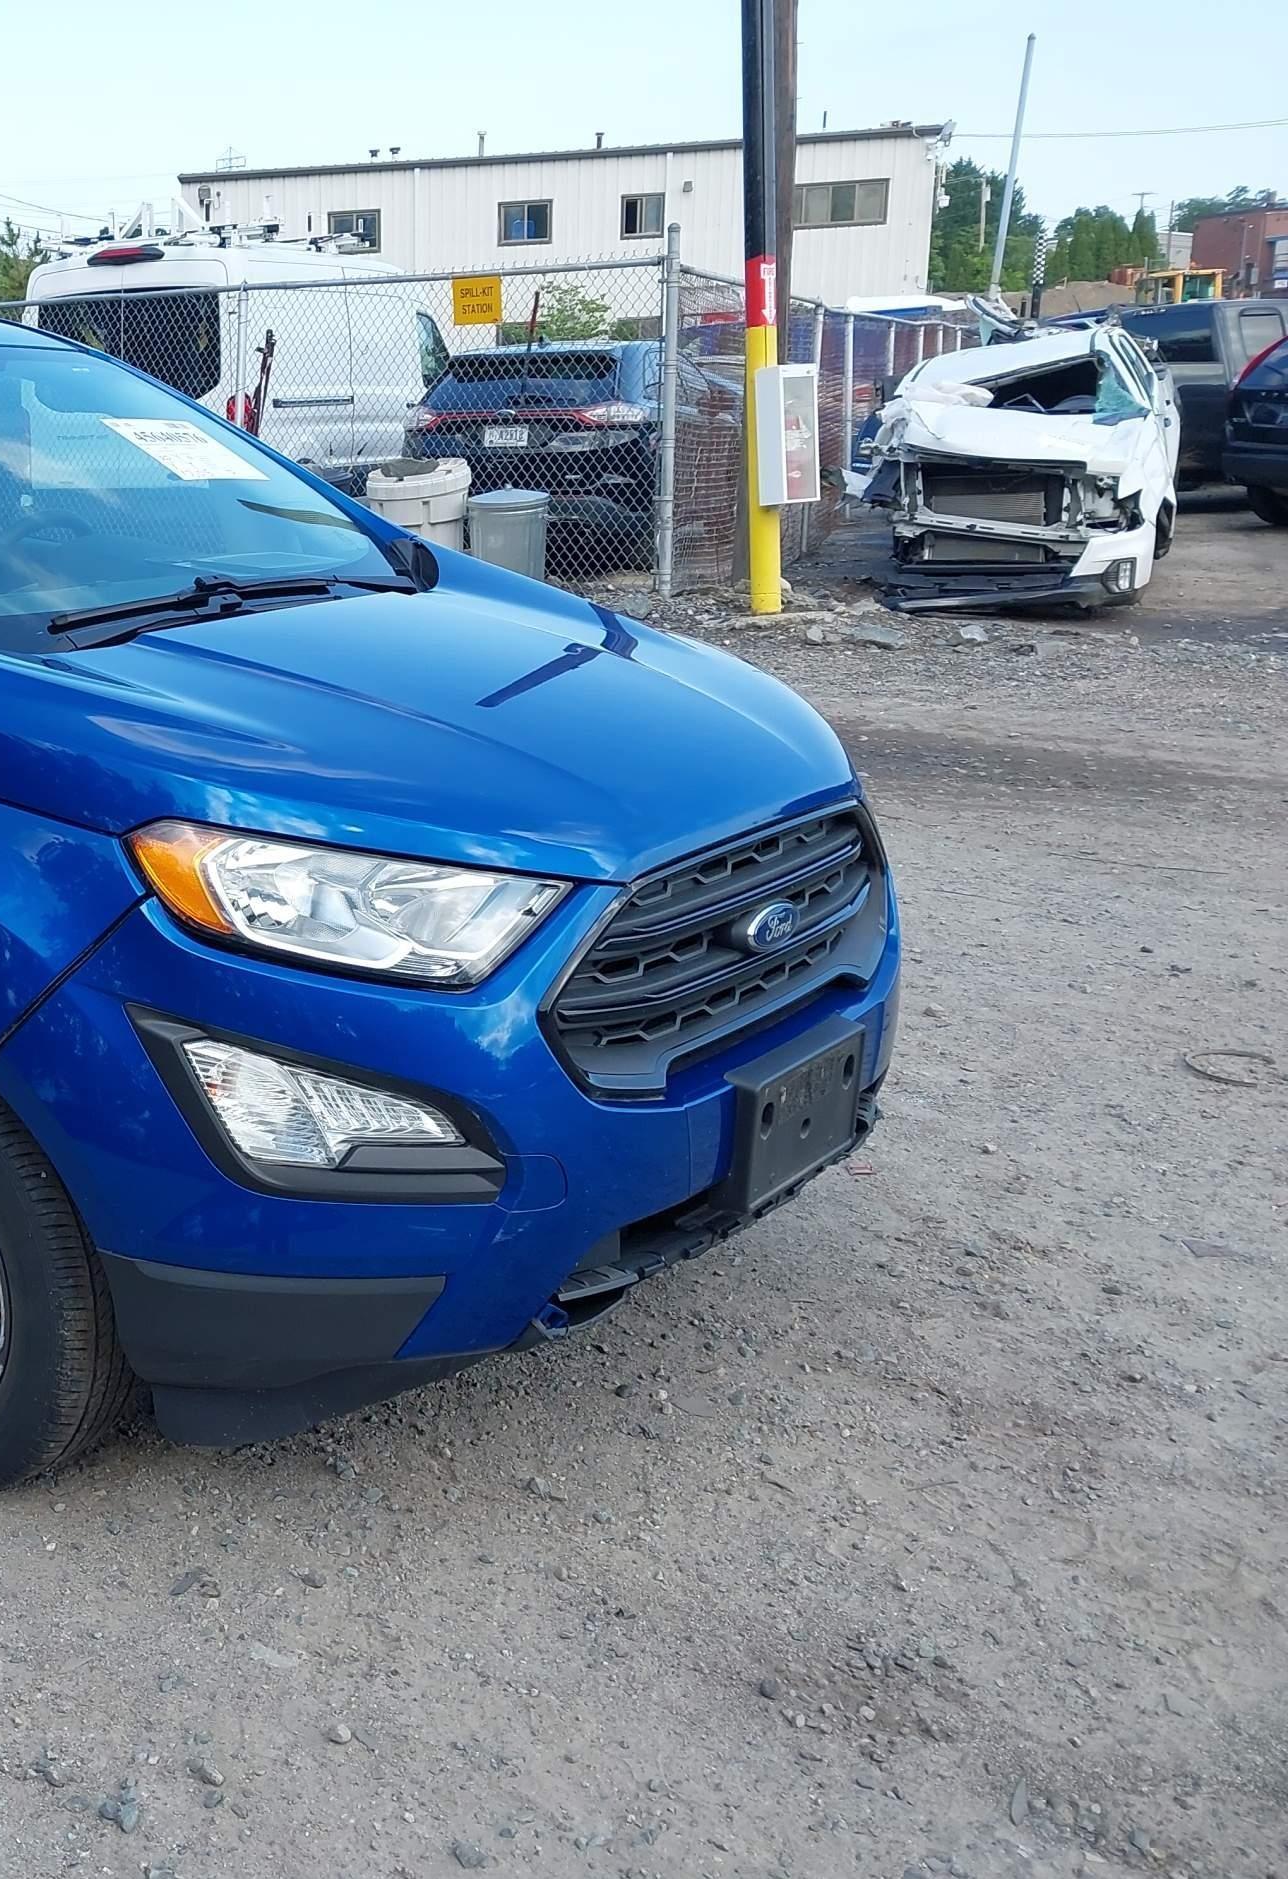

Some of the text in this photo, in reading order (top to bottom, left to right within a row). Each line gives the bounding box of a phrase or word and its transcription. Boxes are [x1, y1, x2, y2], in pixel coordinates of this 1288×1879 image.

[459, 286, 494, 298] SPILL-KIT
[462, 303, 493, 315] STATION
[766, 911, 793, 942] Ford
